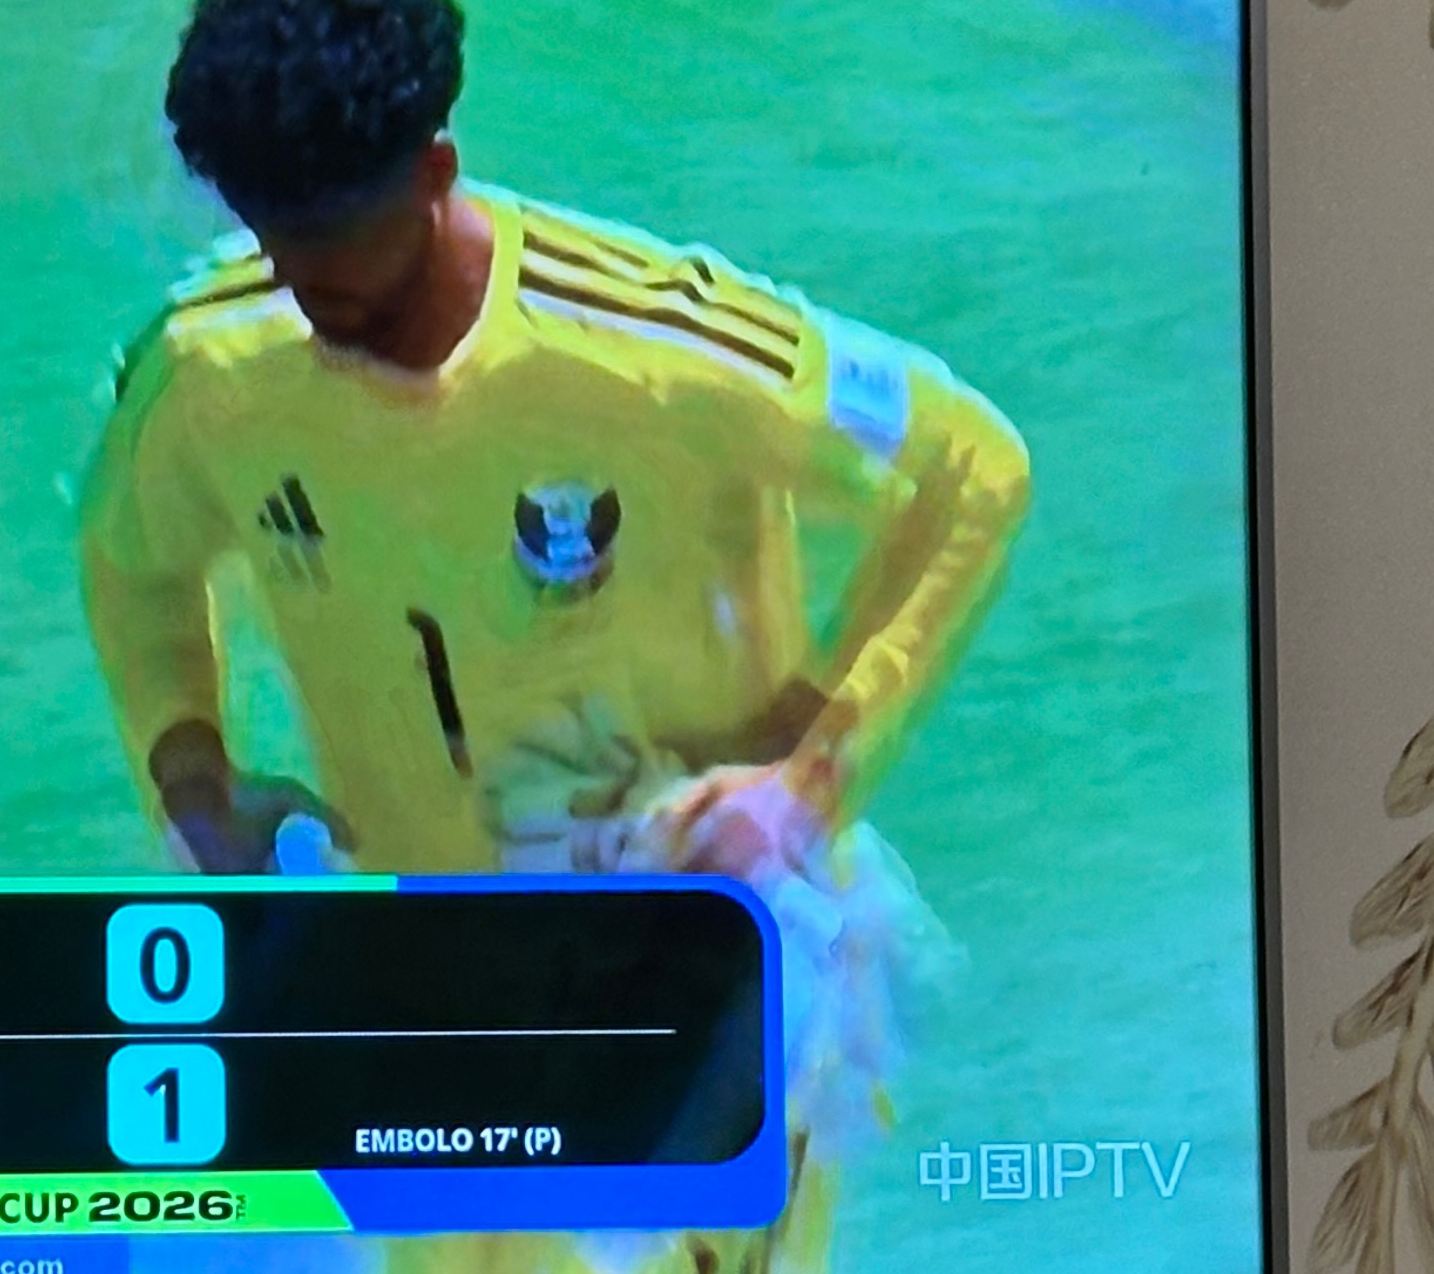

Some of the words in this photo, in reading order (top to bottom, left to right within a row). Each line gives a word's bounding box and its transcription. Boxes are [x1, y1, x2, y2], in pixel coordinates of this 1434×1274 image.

[139, 926, 191, 1004] 0
[142, 1067, 181, 1144] 1
[355, 1128, 474, 1153] EMBOLO
[480, 1127, 518, 1152] 17'
[524, 1127, 562, 1156] (P)
[919, 1141, 1191, 1202] 中国IPTV
[88, 1190, 234, 1222] 2026
